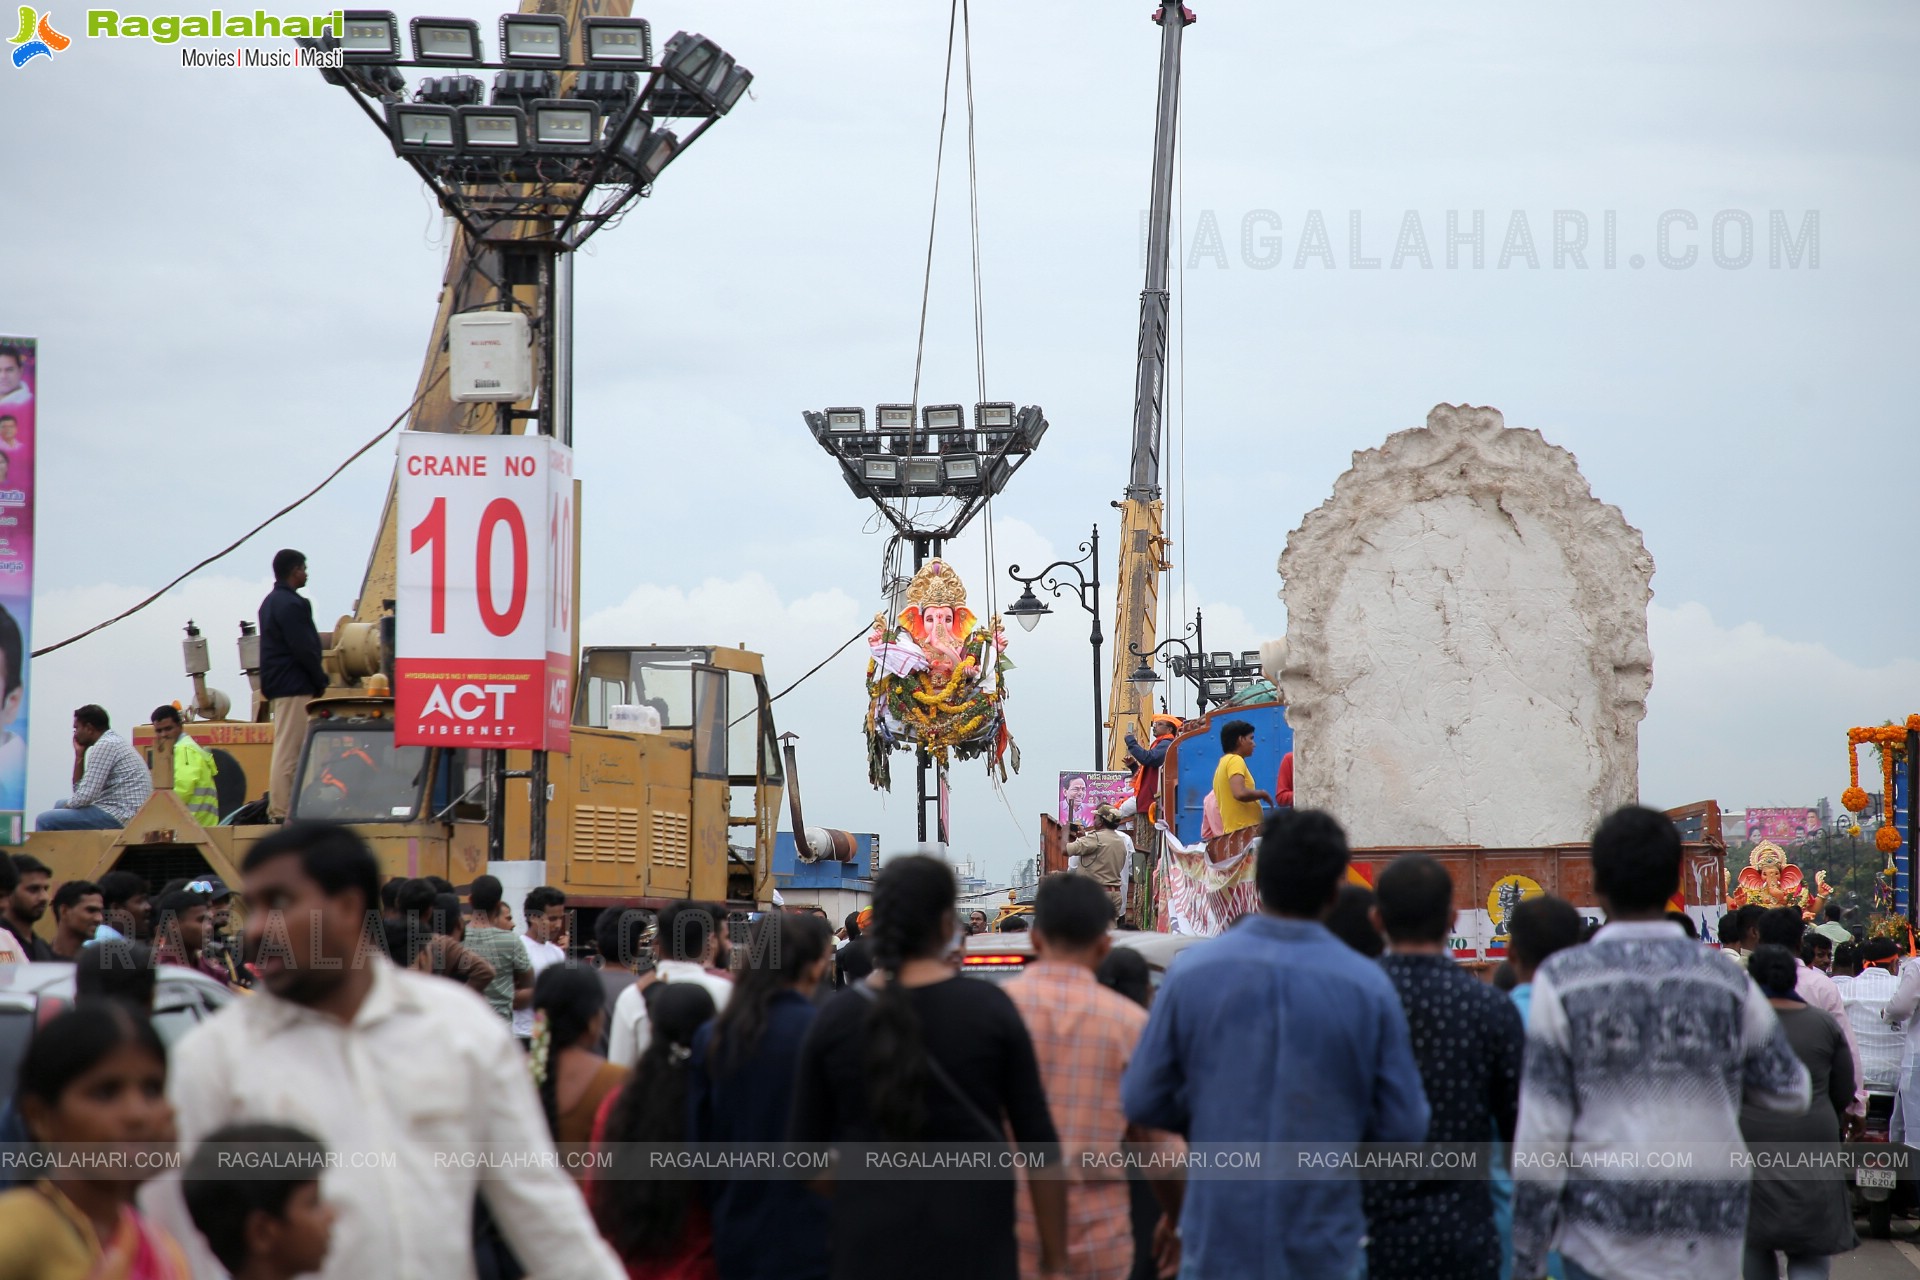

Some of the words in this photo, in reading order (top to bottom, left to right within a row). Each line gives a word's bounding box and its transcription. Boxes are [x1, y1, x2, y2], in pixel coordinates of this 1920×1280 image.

[407, 456, 486, 477] CRANE
[505, 456, 536, 477] NO
[410, 497, 528, 637] 10
[551, 492, 571, 633] 10
[419, 684, 516, 721] ACT
[550, 679, 568, 715] ACT
[418, 725, 516, 736] FIBERNET
